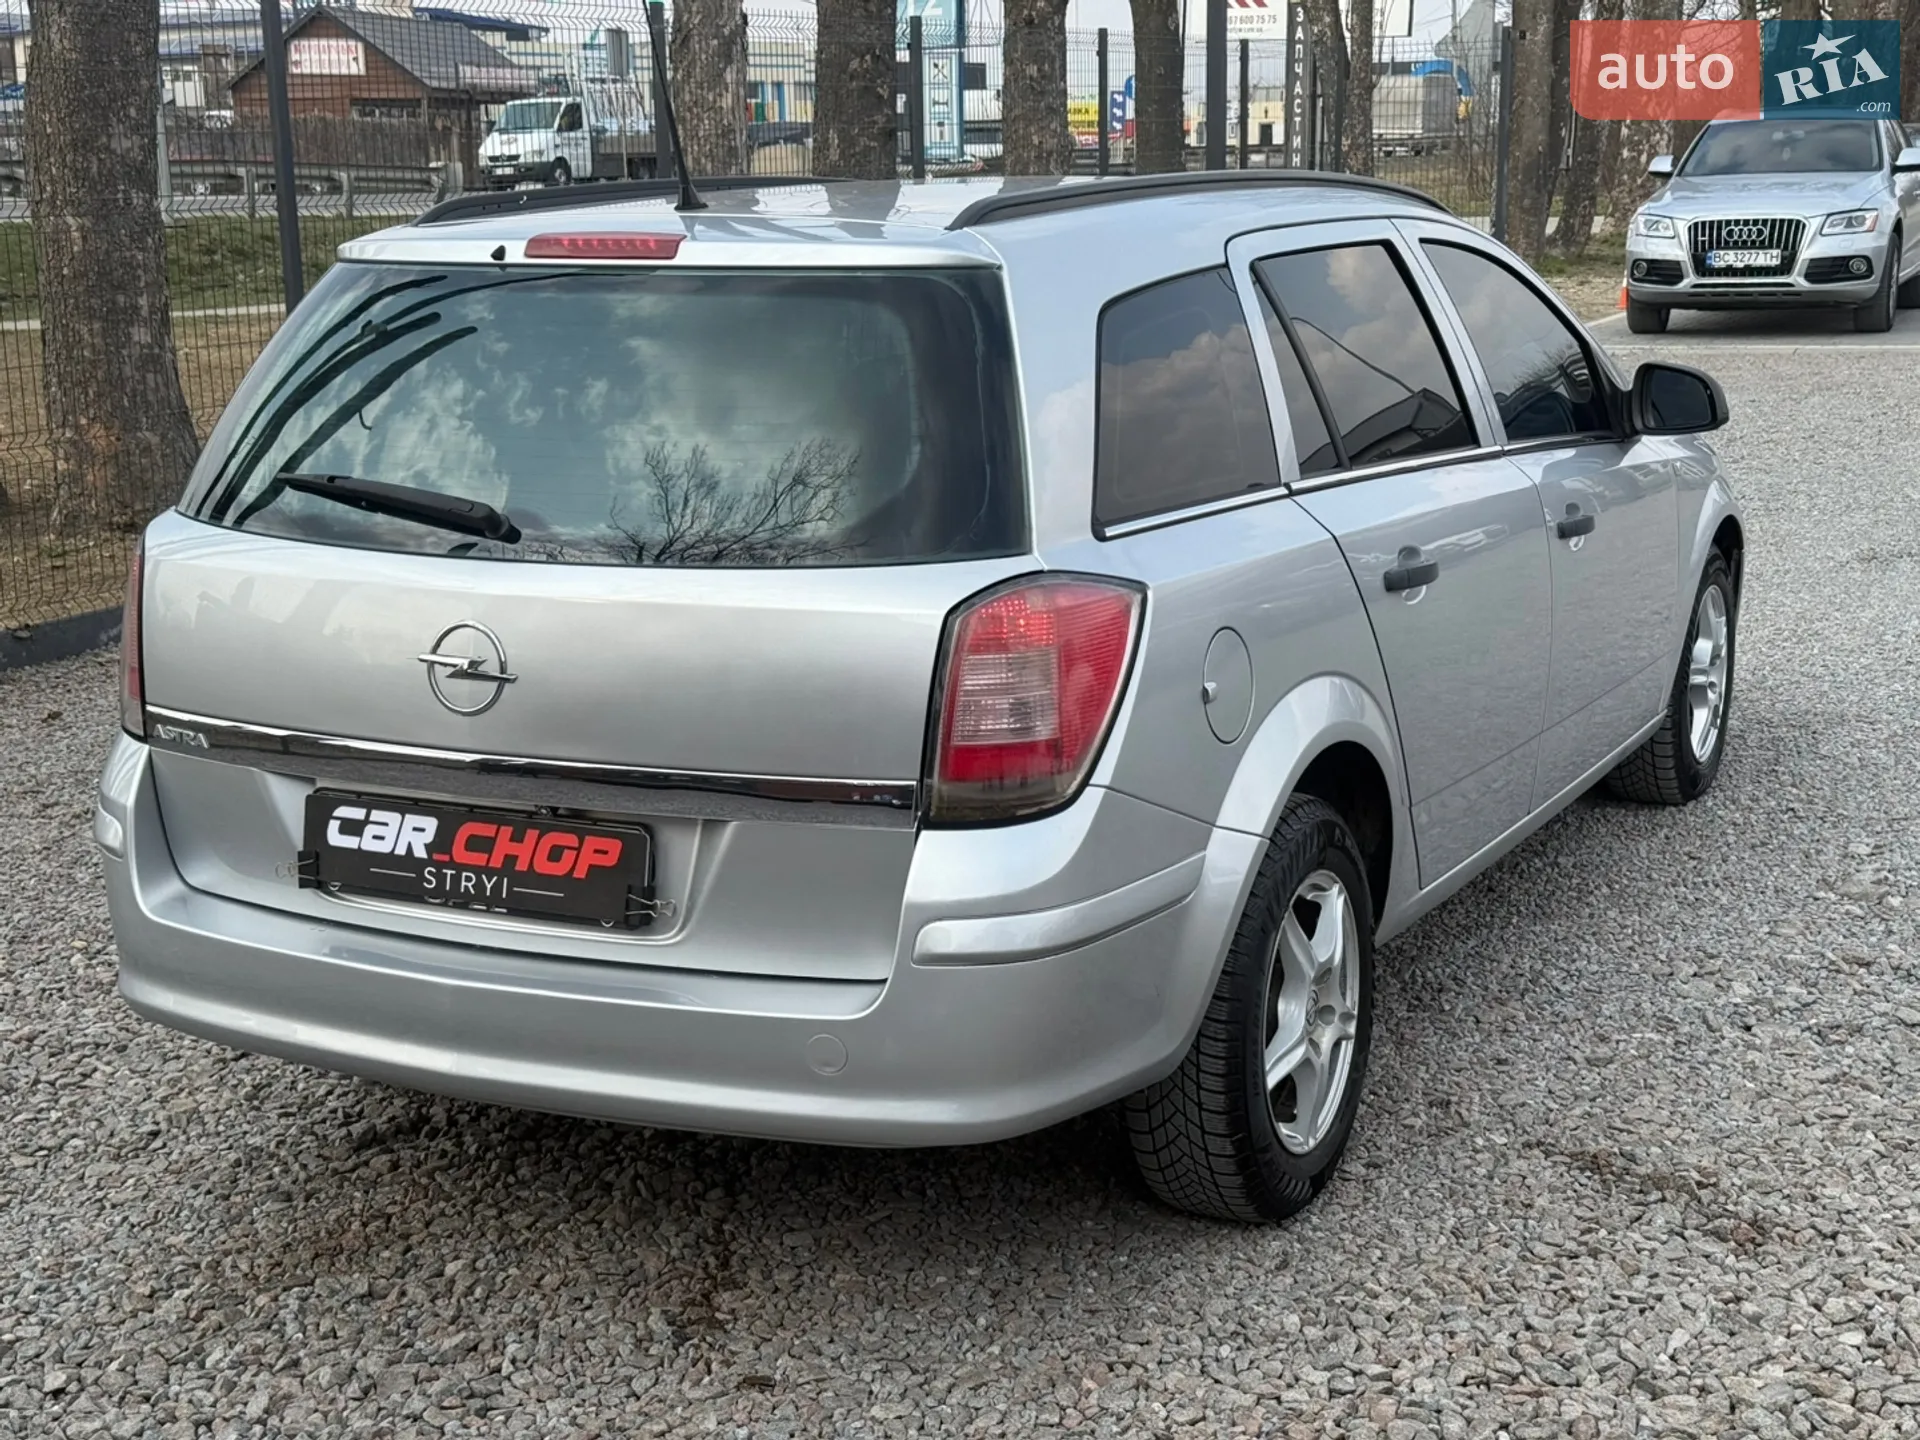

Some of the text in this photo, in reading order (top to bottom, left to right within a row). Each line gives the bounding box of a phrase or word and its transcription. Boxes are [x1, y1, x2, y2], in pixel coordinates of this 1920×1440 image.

[1713, 251, 1780, 263] BC 3277 TH
[153, 723, 209, 749] ASTRA
[423, 866, 508, 899] STRYI
